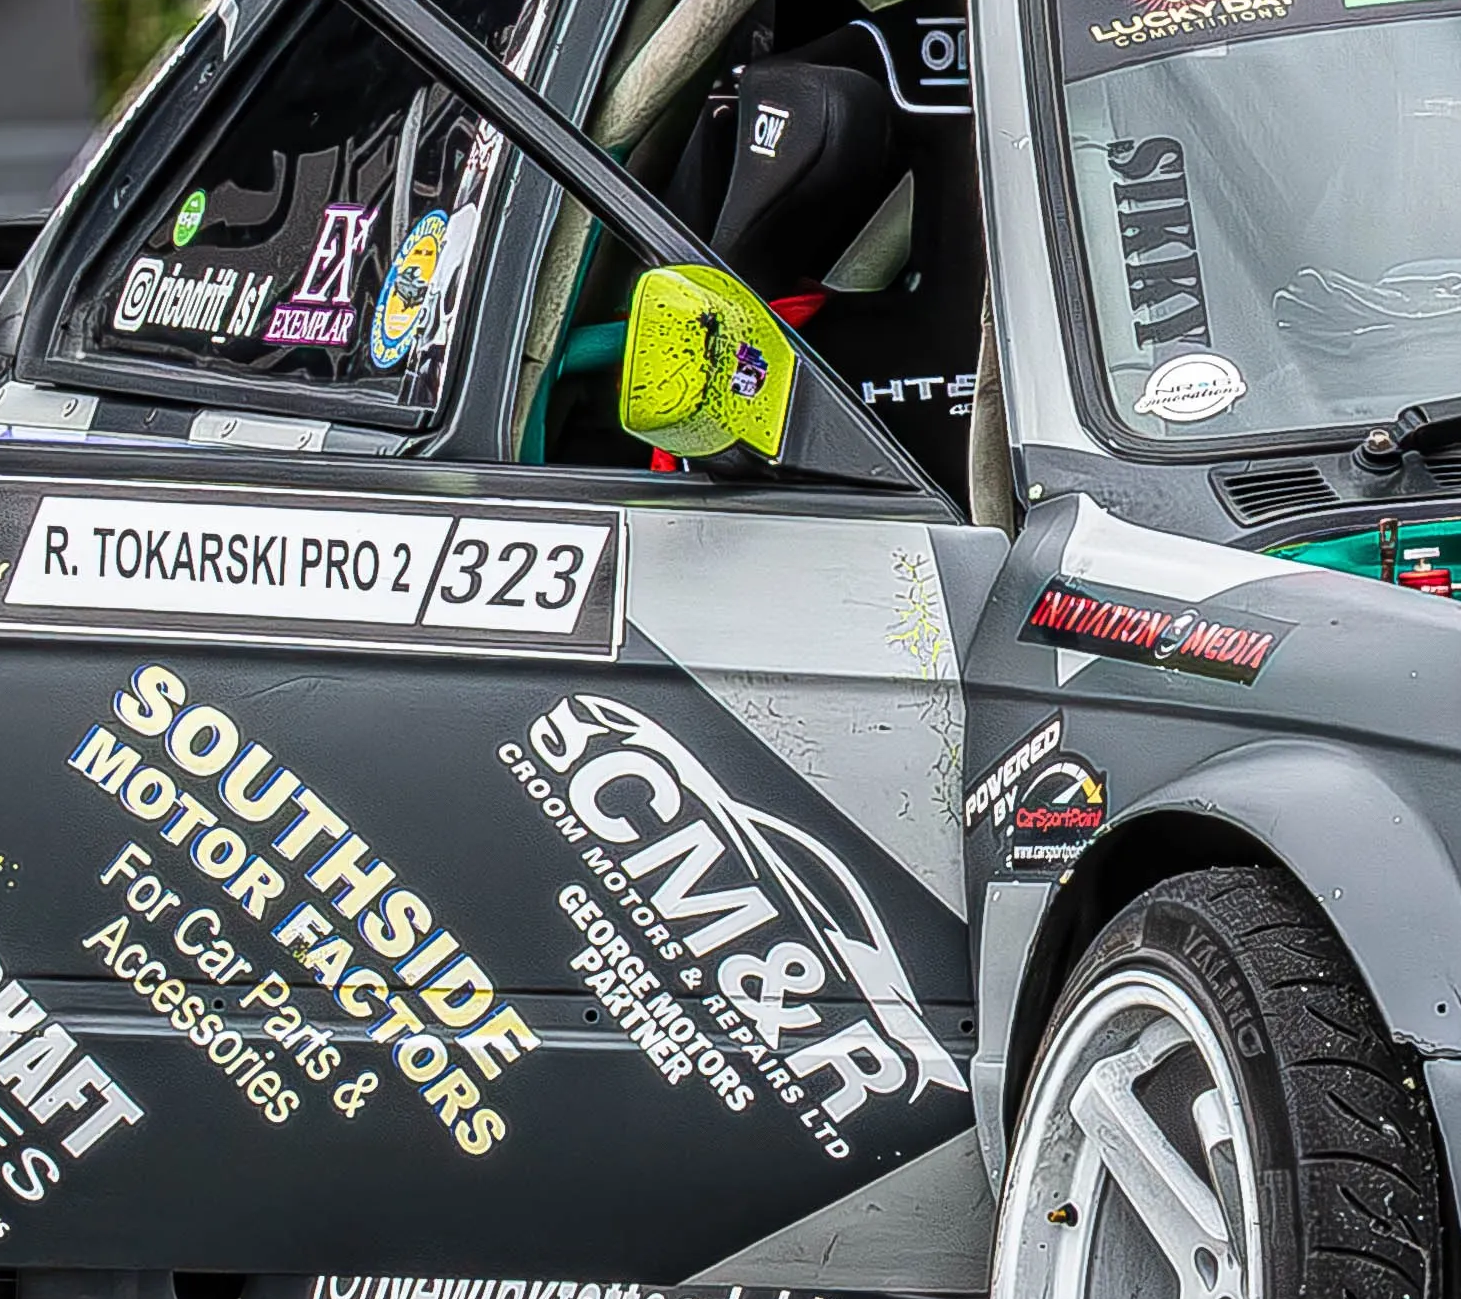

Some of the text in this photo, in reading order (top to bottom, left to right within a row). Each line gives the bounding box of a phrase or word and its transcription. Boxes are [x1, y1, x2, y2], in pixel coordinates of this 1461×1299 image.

[1090, 0, 1216, 44] LUCKY
[1114, 5, 1289, 48] COMPETITIONS
[1108, 136, 1212, 351] SIKKY
[266, 308, 356, 344] EXEMPLAR
[44, 524, 412, 593] R. TOKARSKI PRO 2
[440, 537, 585, 611] 323
[1030, 590, 1274, 669] INITIATION MEDIA
[964, 720, 1062, 828] POWERED
[993, 785, 1019, 827] BY
[113, 663, 543, 1081] SOUTHSIDE
[67, 723, 507, 1156] MOTOR FACTORS
[99, 840, 380, 1119] For Car Parts &
[497, 741, 852, 1160] CROOM MOTORS & REPAIRS LTD
[557, 883, 756, 1113] GEORGE MOTORS
[81, 914, 301, 1124] Accessories
[569, 944, 694, 1088] PARTNER
